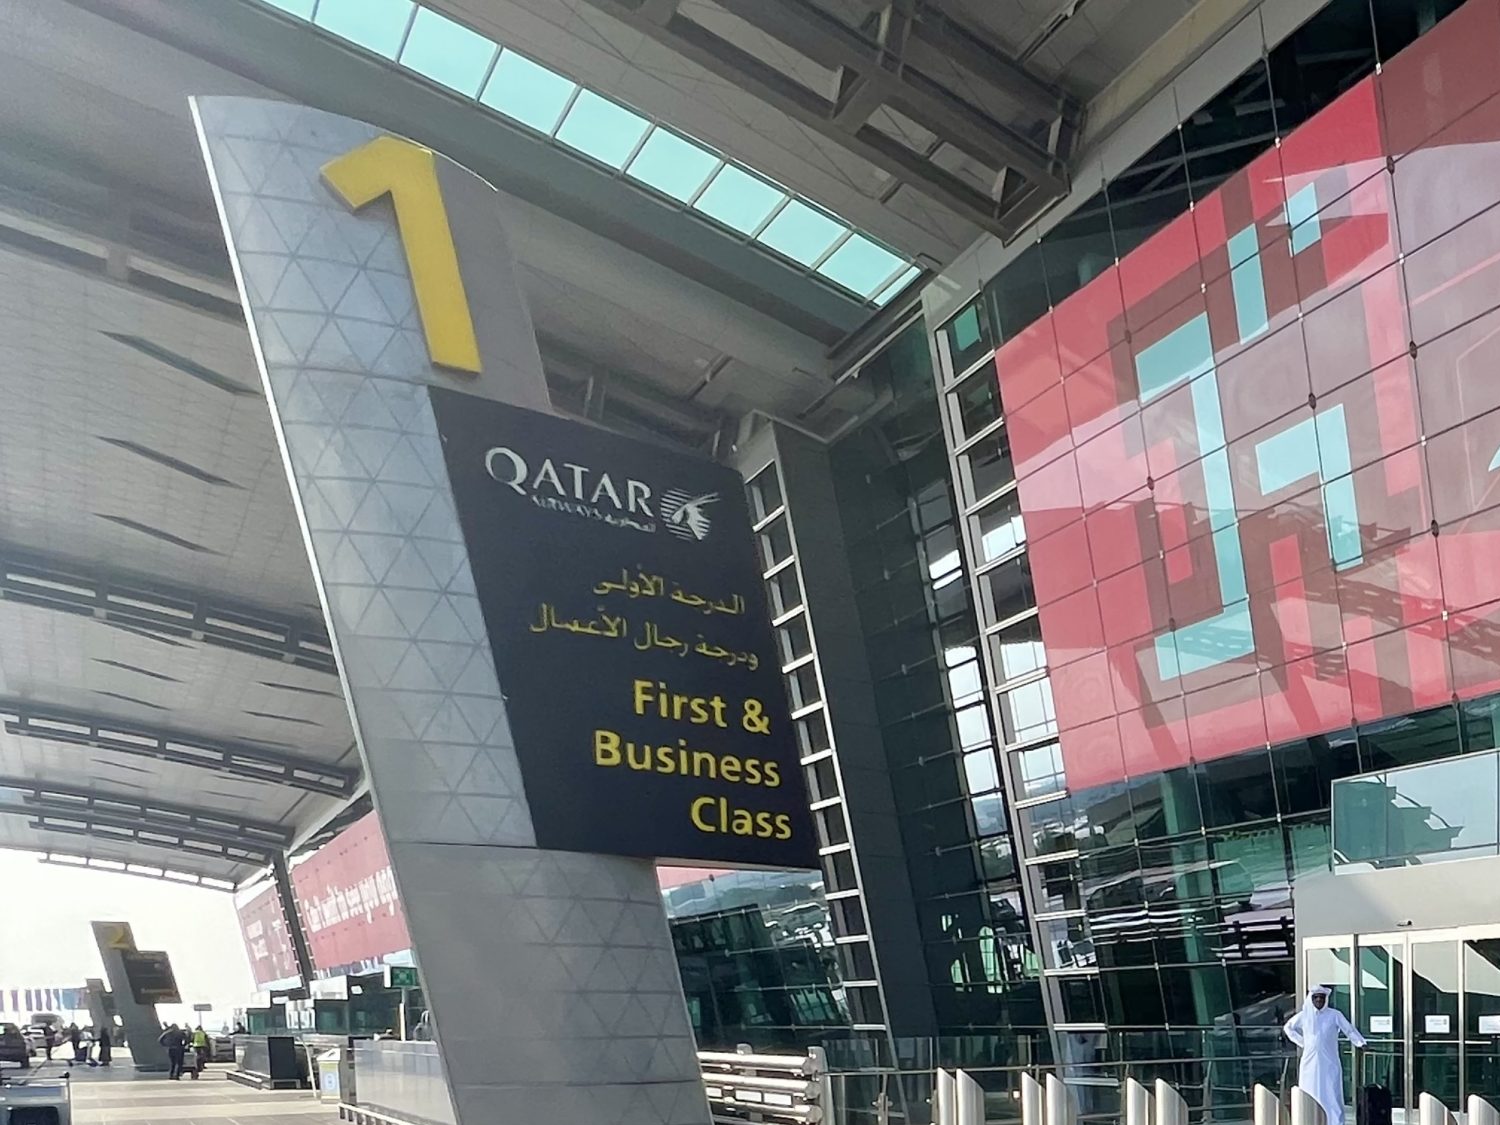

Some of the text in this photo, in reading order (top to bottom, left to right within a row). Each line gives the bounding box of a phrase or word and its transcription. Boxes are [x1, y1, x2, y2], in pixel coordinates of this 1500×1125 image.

[318, 135, 482, 374] 1
[484, 446, 655, 518] QATAR
[593, 563, 745, 615] الدرجة الأولى
[634, 621, 689, 658] رجال
[694, 633, 759, 671] ودرجة
[633, 679, 771, 735] First &
[594, 729, 780, 788] Business
[690, 796, 792, 840] Class
[103, 926, 130, 950] 2
